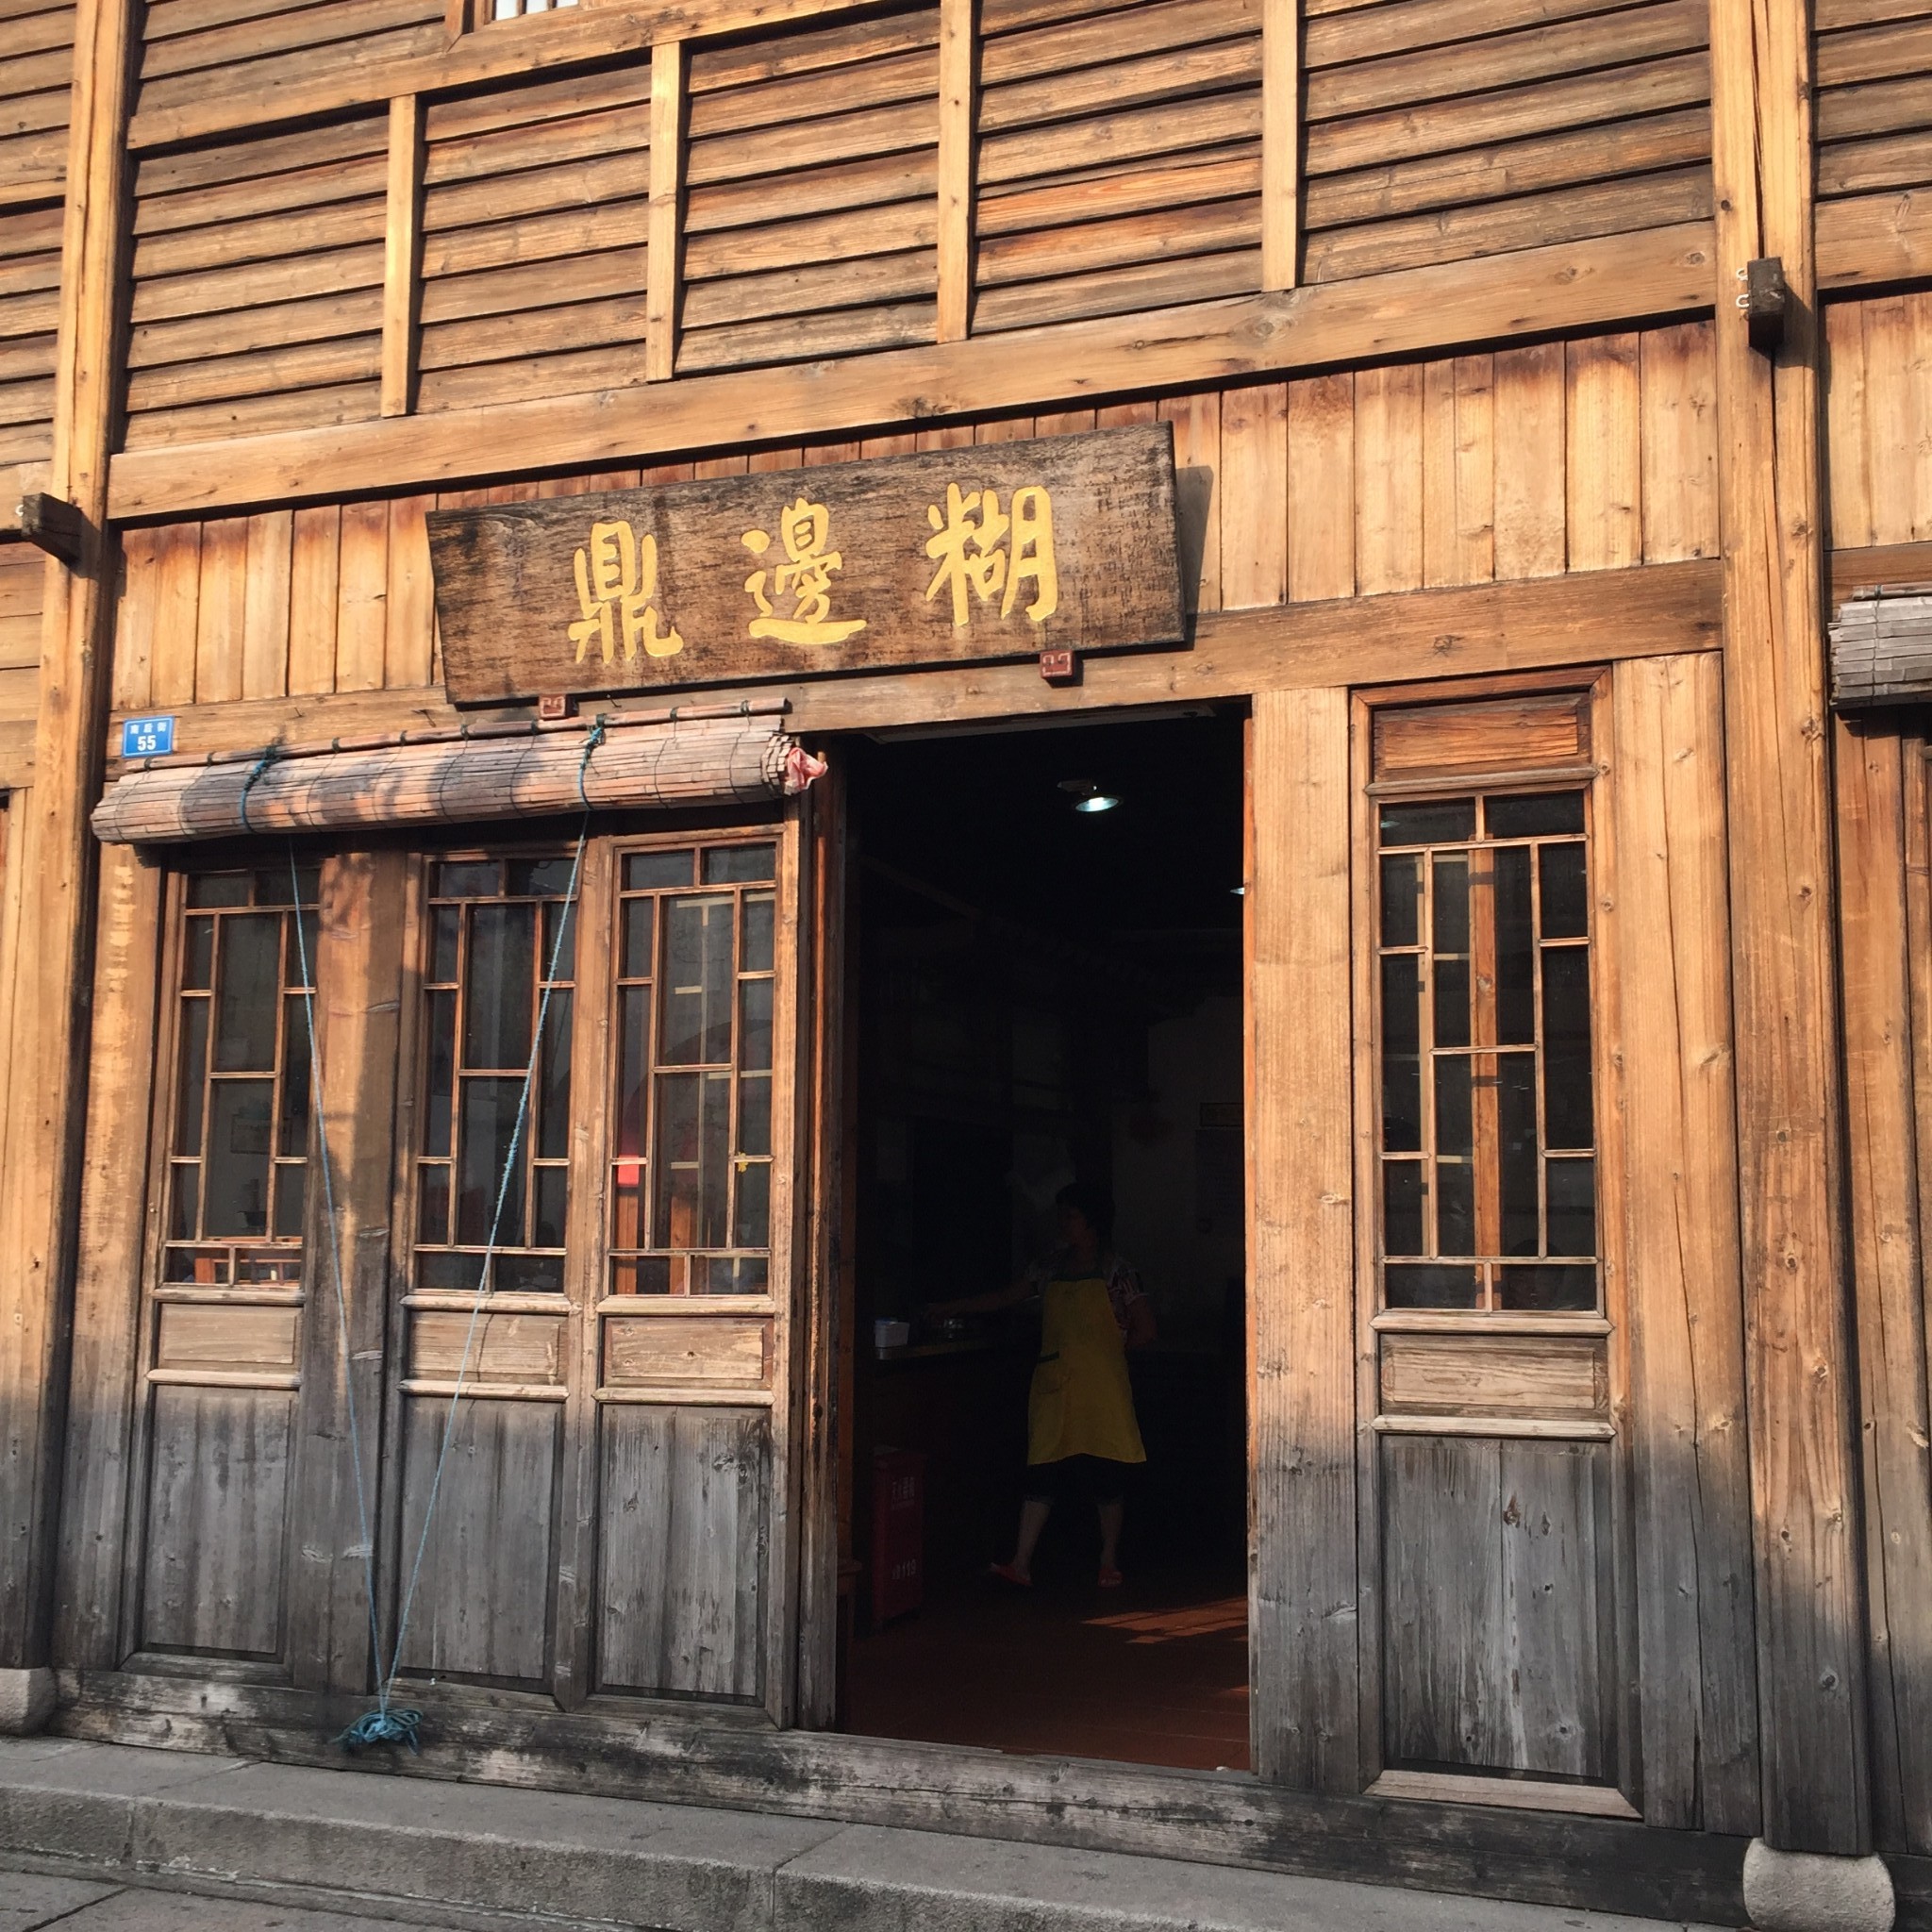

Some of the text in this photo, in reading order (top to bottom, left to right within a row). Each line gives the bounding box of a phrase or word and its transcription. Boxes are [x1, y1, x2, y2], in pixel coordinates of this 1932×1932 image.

[568, 481, 1060, 664] 鼎邊糊
[137, 735, 157, 752] 55
